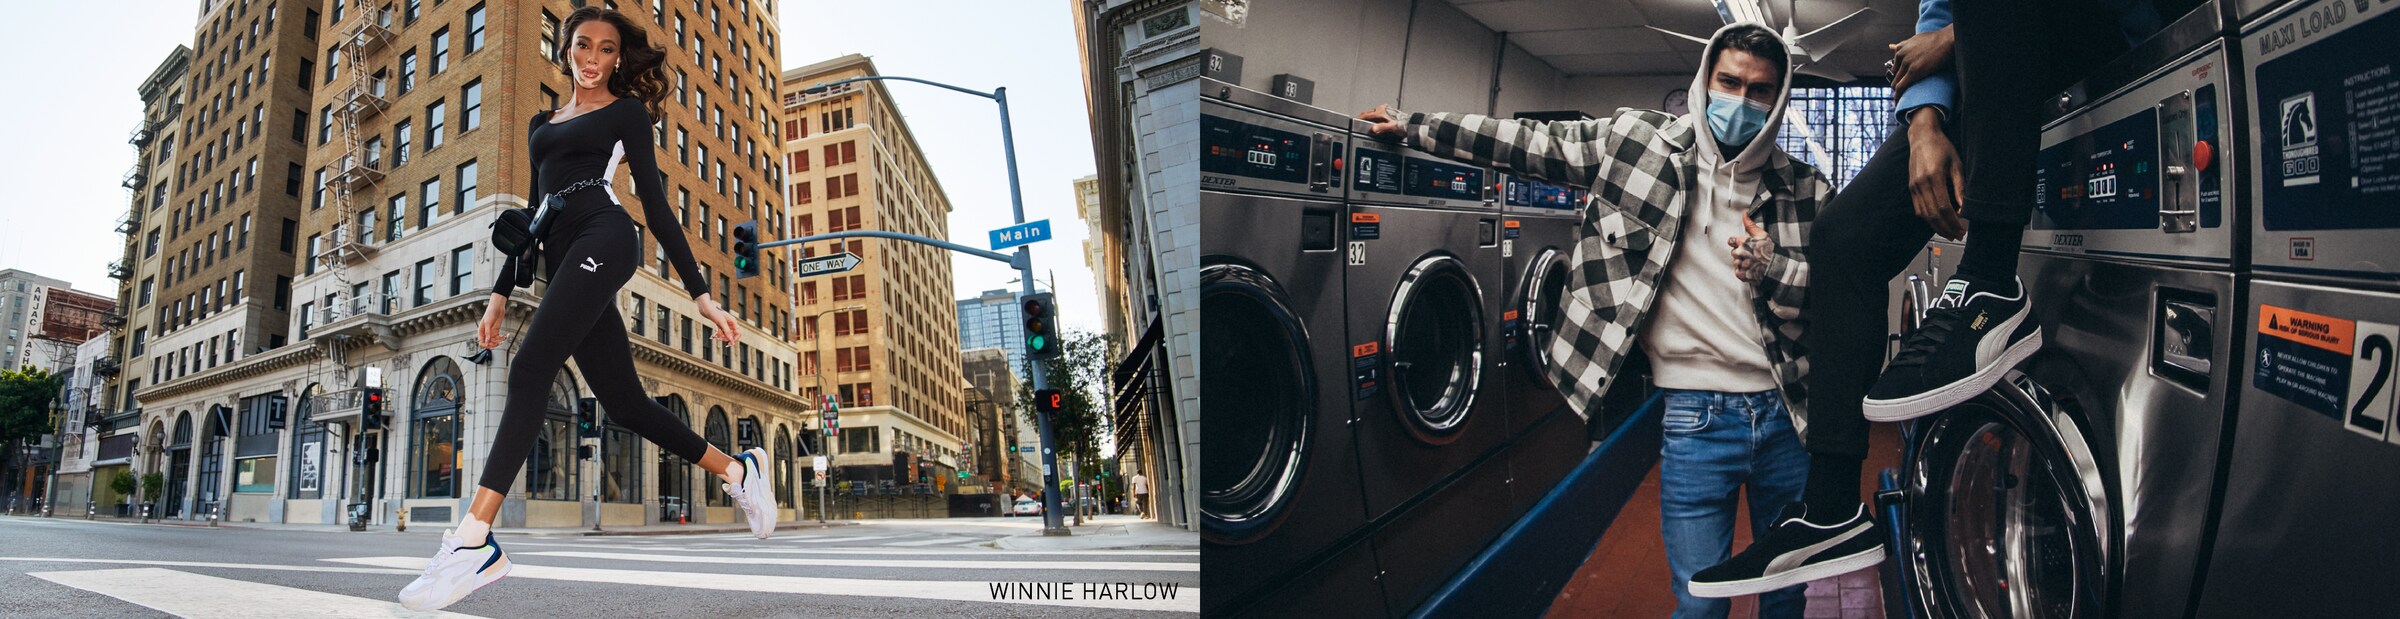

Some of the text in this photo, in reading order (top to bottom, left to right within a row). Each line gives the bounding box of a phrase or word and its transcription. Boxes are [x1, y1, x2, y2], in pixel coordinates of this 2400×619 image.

[2259, 1, 2346, 56] MAXI LOAD
[1210, 56, 1221, 72] 32
[2343, 65, 2391, 87] INSTRUCTIONS
[1286, 83, 1296, 97] 33
[2282, 155, 2320, 177] 600
[1201, 175, 1236, 186] DEXTER
[1000, 227, 1040, 243] Main
[2053, 234, 2084, 246] DEXTER
[1350, 243, 1364, 264] 32
[2295, 248, 2308, 257] USA
[802, 259, 846, 273] ONE WAY
[30, 286, 41, 325] ANJAC
[2290, 317, 2330, 334] WARNING
[2298, 329, 2320, 340] SERIOUS
[2277, 351, 2291, 361] NEVER
[2307, 360, 2330, 372] CHILDREN
[2277, 364, 2297, 374] OPERATE
[272, 398, 286, 419] T
[1051, 393, 1060, 408] 12
[739, 420, 751, 438] T
